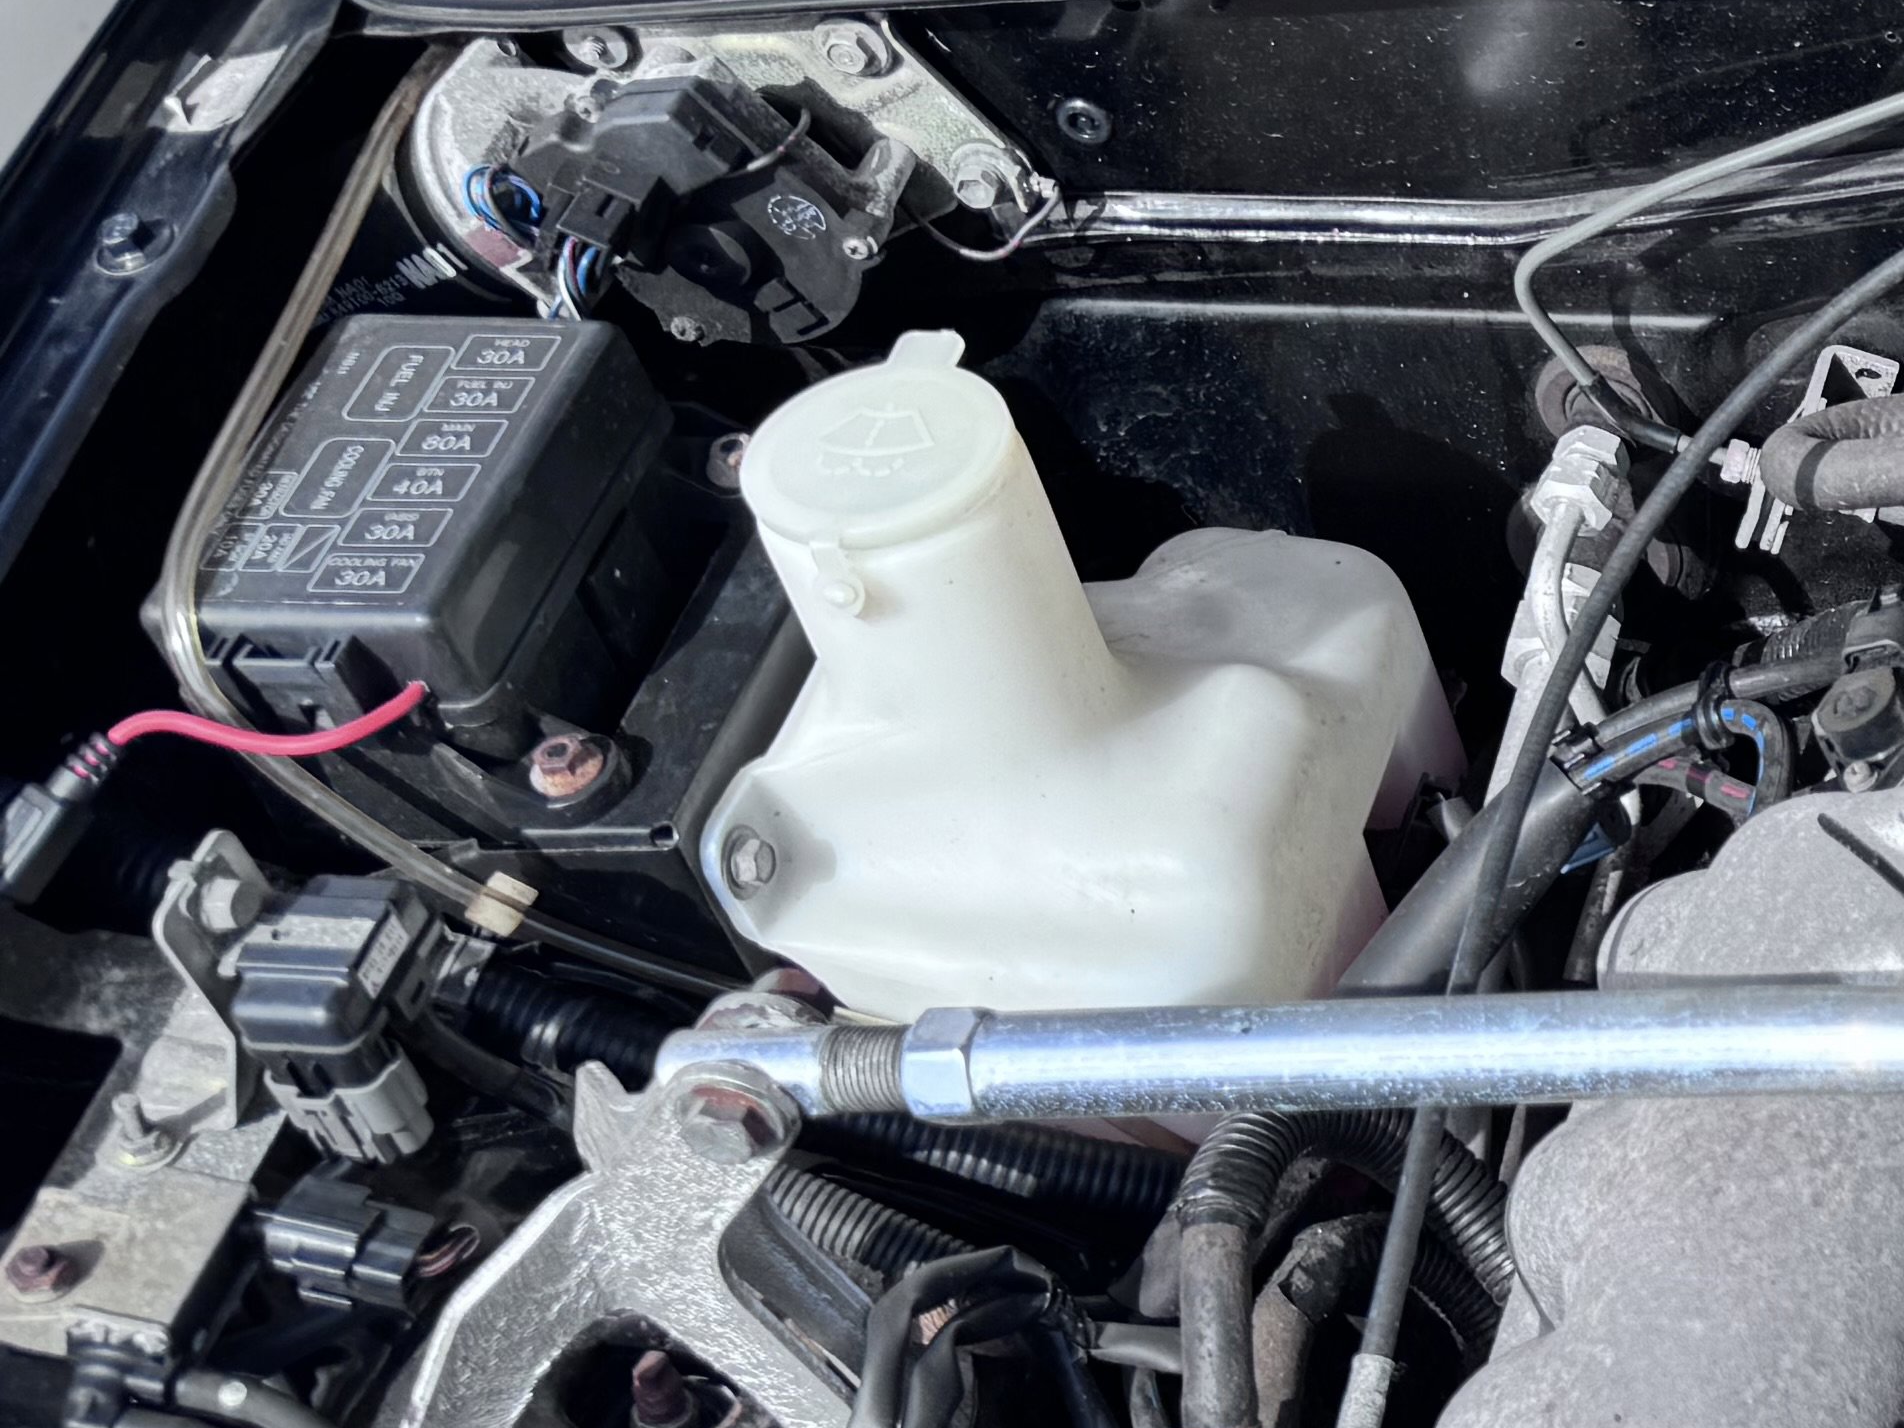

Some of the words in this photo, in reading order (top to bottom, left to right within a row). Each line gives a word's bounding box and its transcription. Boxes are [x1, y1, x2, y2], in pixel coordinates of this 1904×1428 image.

[476, 348, 525, 364] 30A
[390, 354, 424, 387] FUEL
[374, 392, 400, 412] INJ
[450, 392, 499, 407] 30A
[324, 445, 365, 486] COOLING
[393, 478, 444, 495] 40A
[364, 524, 415, 540] 30A
[329, 557, 387, 566] COOLING
[335, 569, 387, 586] 30A
